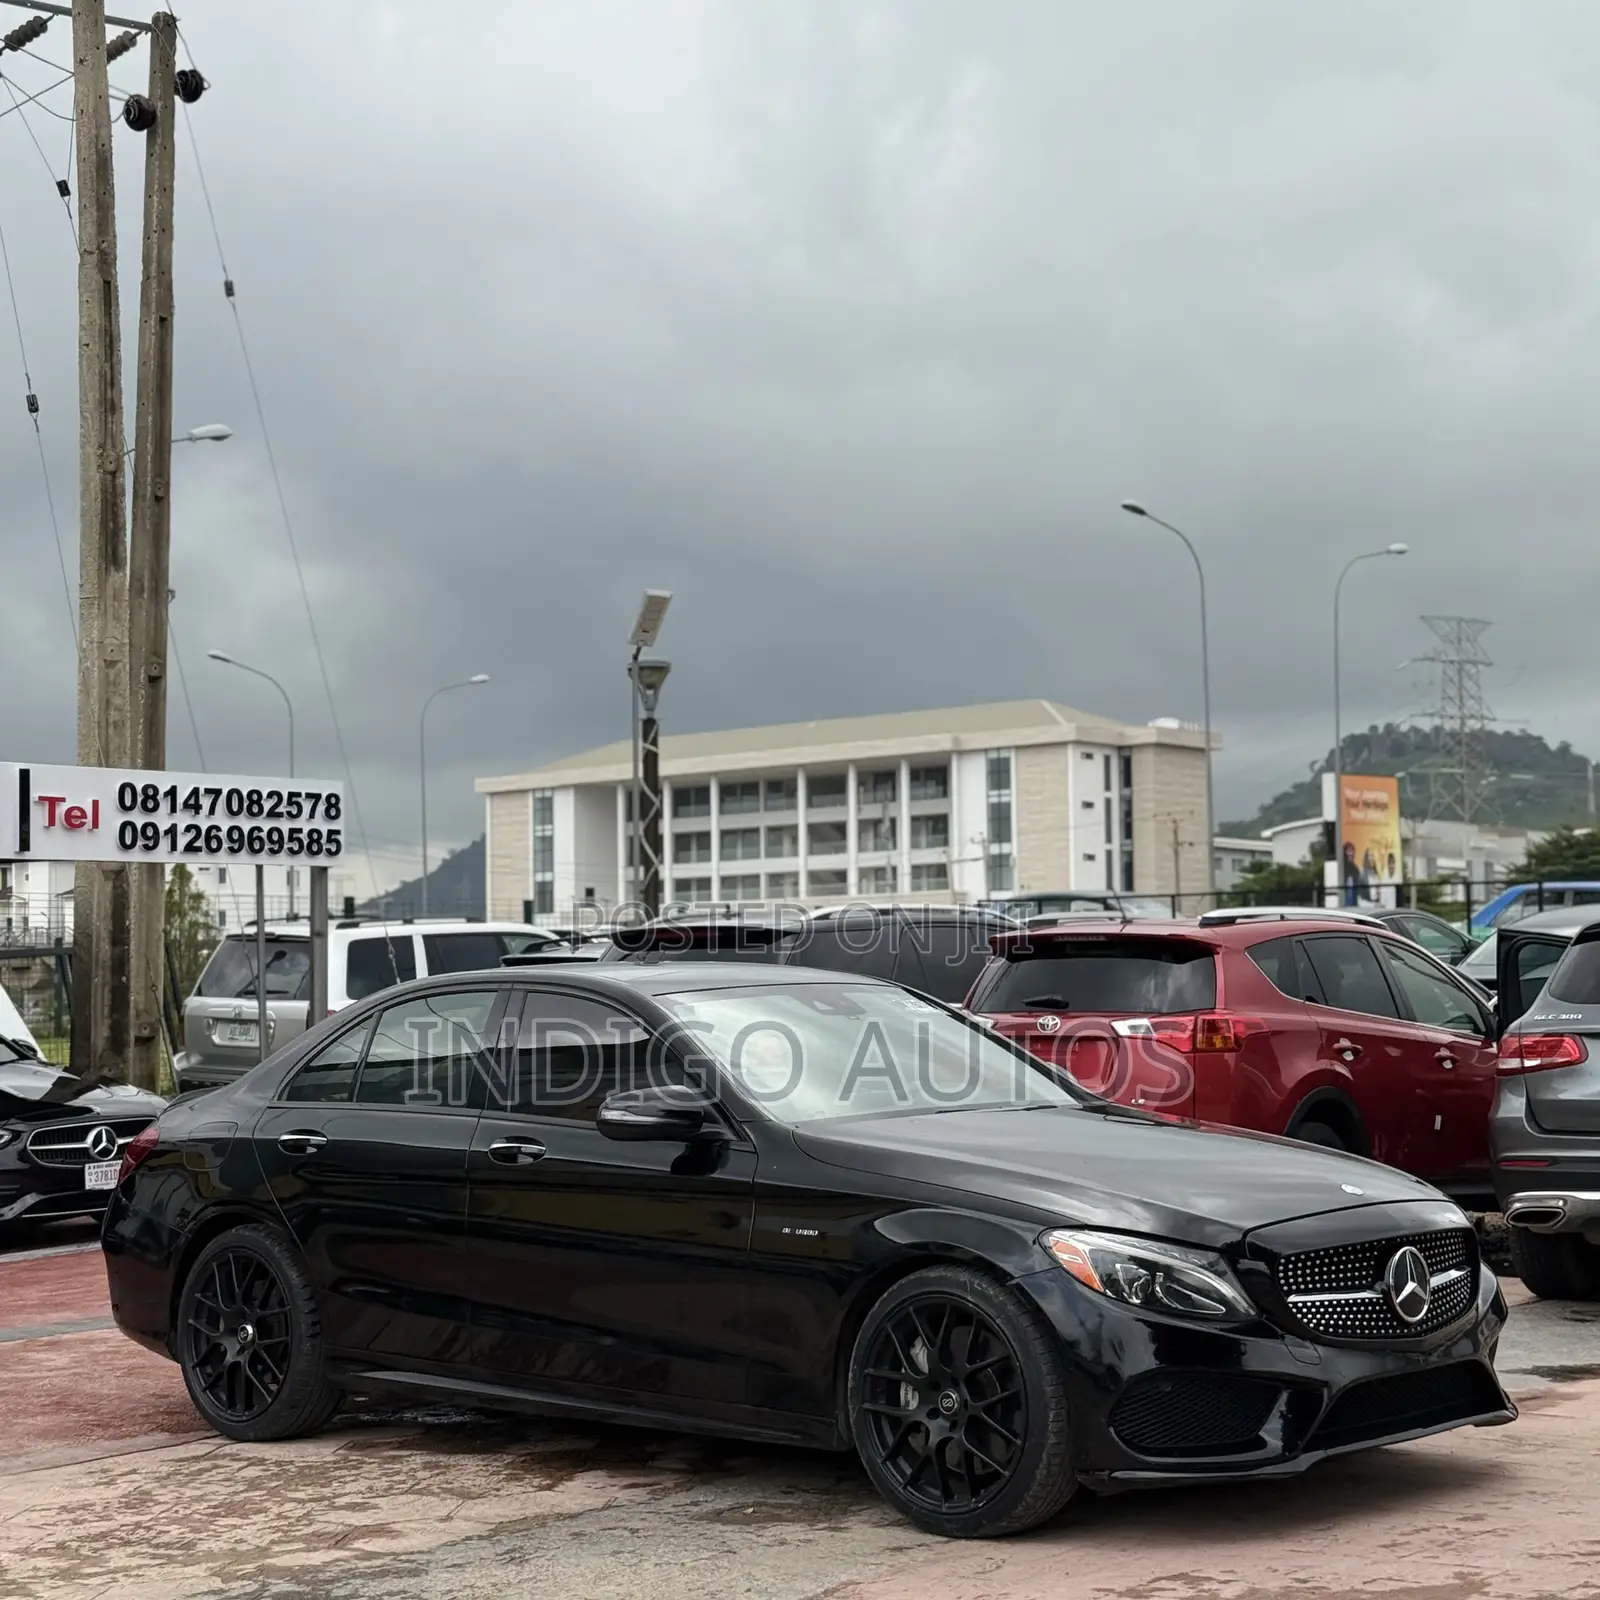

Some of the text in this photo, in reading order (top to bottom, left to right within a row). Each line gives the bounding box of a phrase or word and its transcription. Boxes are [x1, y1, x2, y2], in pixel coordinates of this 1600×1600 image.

[38, 796, 99, 830] Tel
[117, 782, 341, 820] 08147082578
[118, 821, 342, 856] 09126969585
